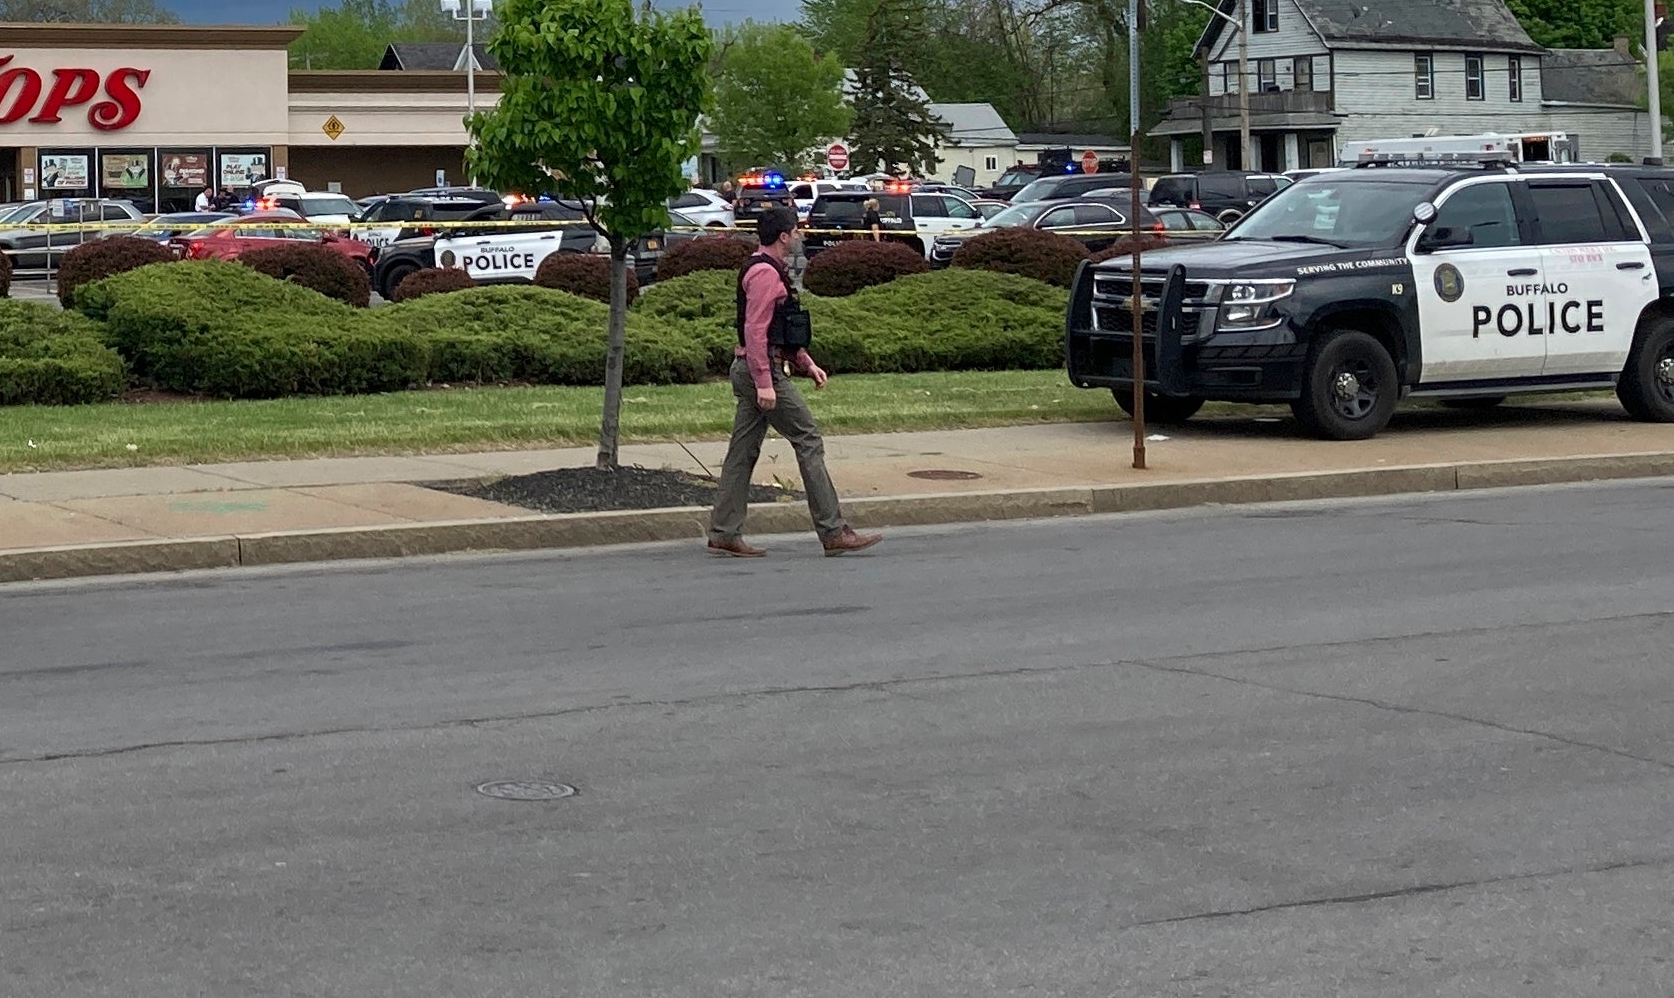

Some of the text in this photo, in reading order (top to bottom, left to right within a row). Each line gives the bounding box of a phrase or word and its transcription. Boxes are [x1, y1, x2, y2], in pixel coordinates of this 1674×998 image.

[463, 253, 534, 271] POLICE
[1297, 257, 1409, 275] SERVING THE COMMUNITY
[1391, 284, 1403, 295] K9
[1506, 282, 1568, 296] BUFFALO
[1472, 299, 1604, 339] POLICE
